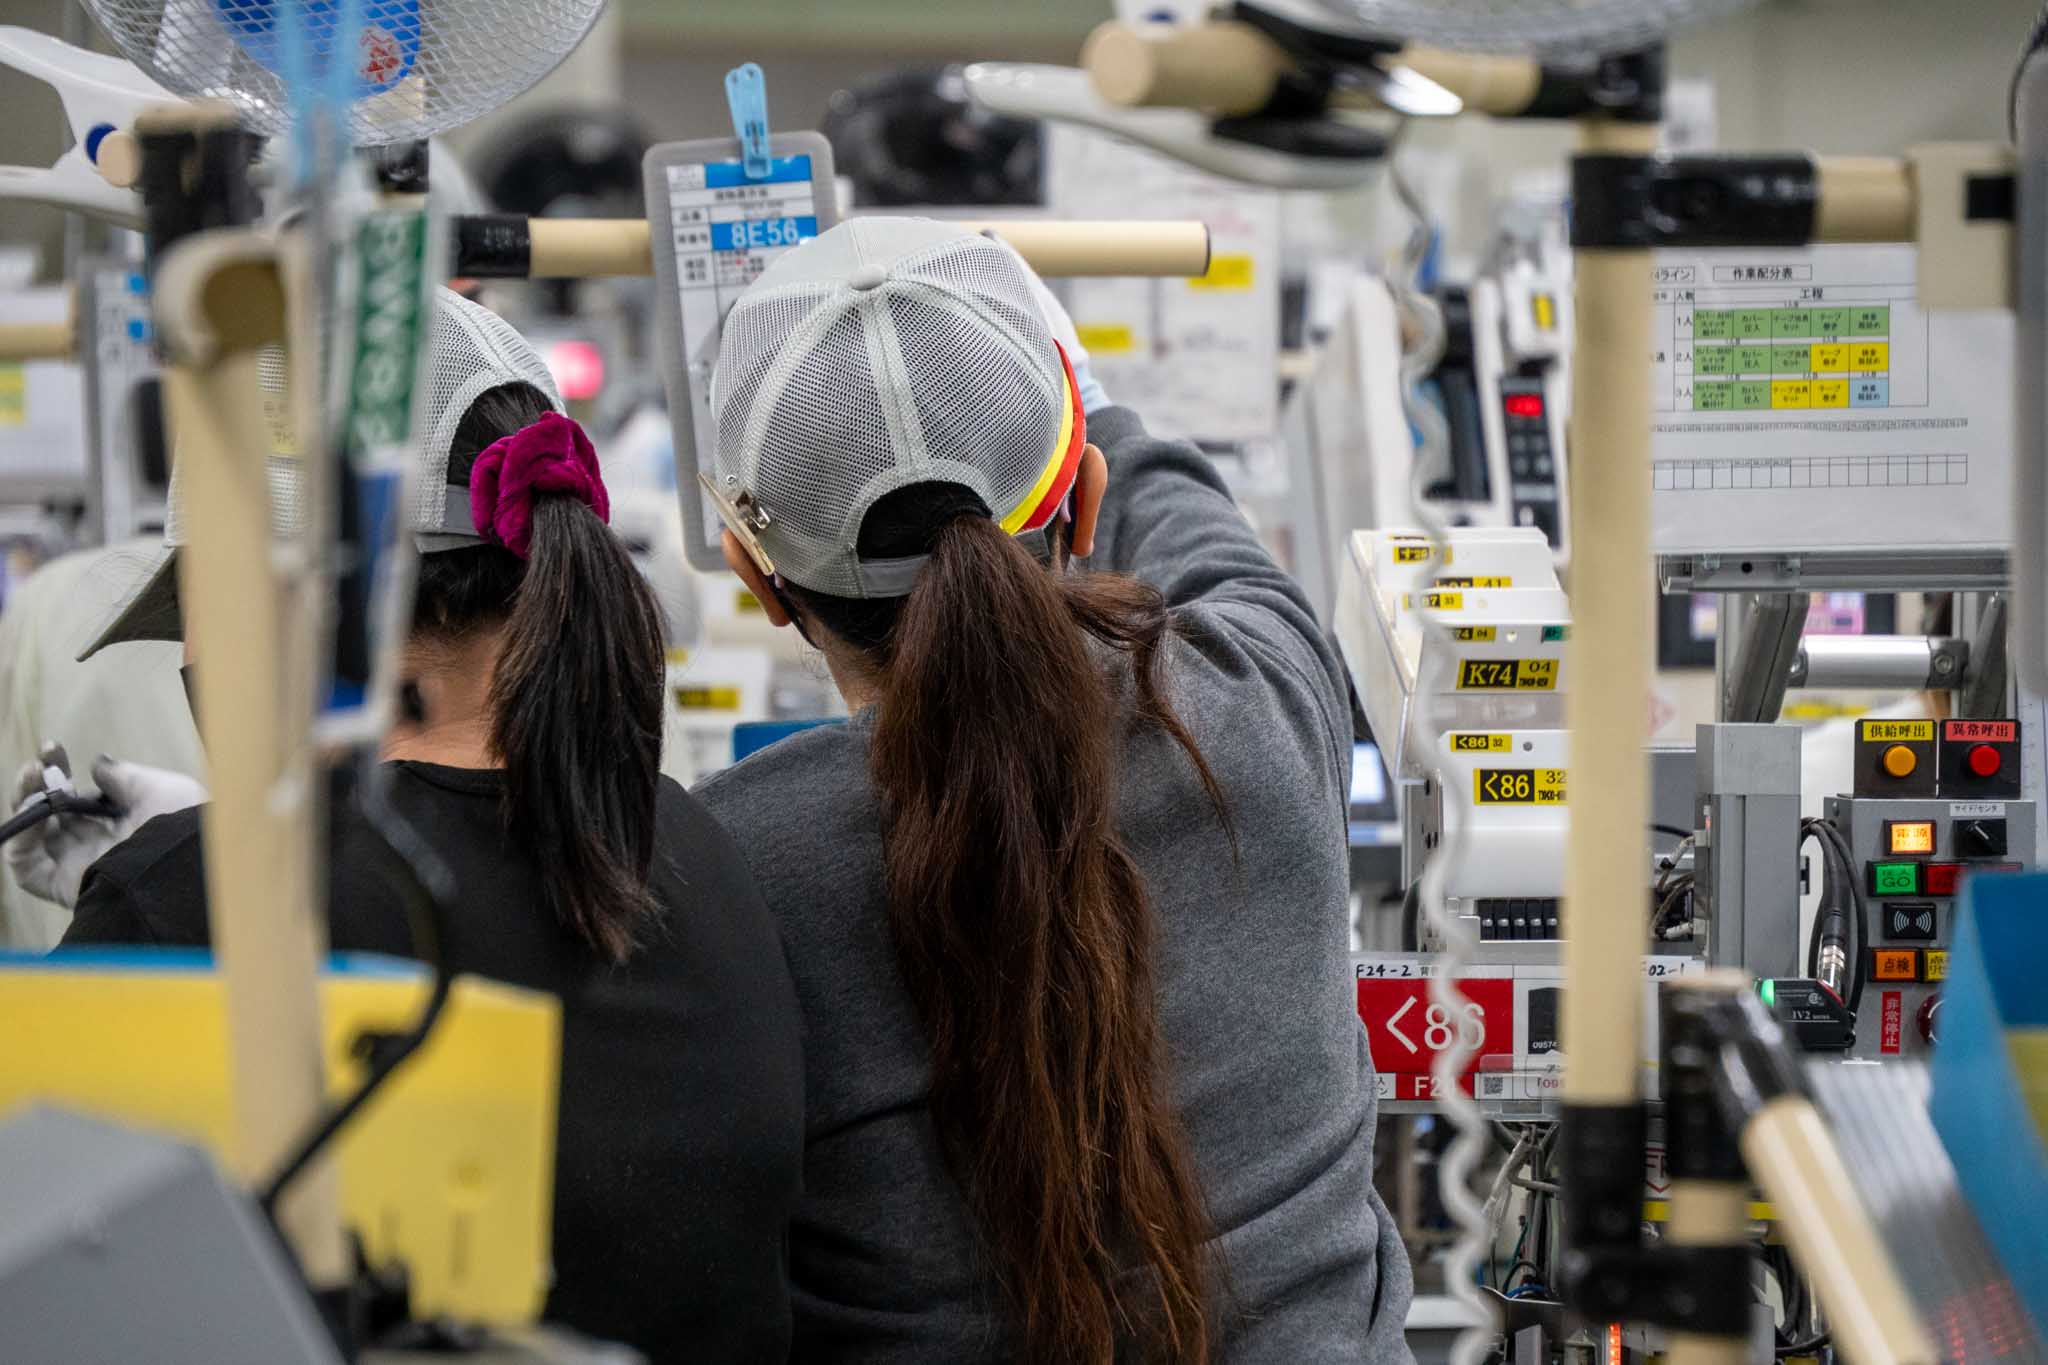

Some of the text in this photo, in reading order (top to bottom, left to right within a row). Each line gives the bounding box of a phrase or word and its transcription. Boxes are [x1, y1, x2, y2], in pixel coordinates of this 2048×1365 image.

[731, 217, 799, 247] 8E56
[1733, 266, 1793, 280] 作業配分表
[1800, 288, 1823, 299] 工程
[1468, 663, 1513, 686] K74
[1529, 660, 1551, 673] 04
[1870, 724, 1926, 738] 供給呼出
[1952, 723, 2008, 737] 異常呼出
[1493, 738, 1503, 747] 32
[1546, 770, 1567, 784] 32
[1882, 876, 1911, 888] GO
[1356, 963, 1412, 978] F24-2
[1884, 956, 1910, 974] 点検
[1791, 1009, 1812, 1020] IV2
[1884, 998, 1900, 1047] 非常停止
